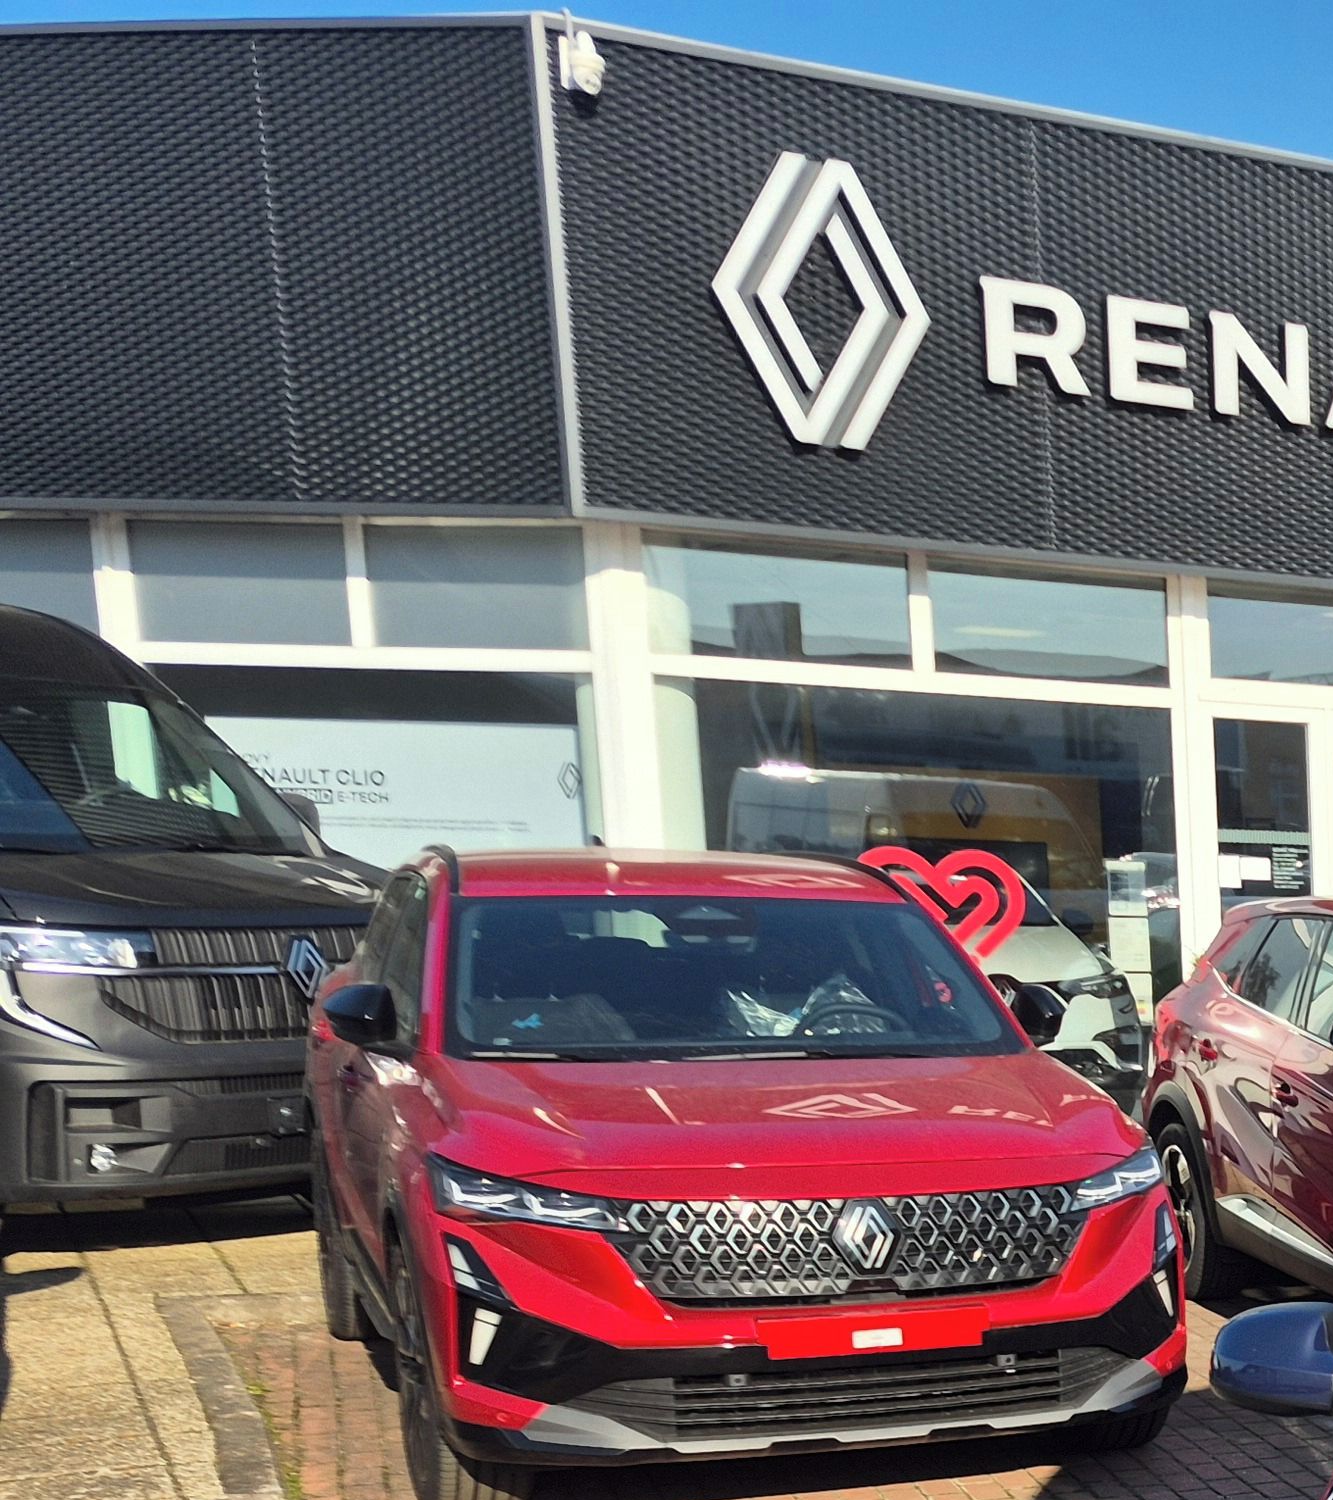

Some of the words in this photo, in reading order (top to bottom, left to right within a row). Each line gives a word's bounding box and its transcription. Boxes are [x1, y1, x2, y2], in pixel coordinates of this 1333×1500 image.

[254, 767, 330, 784] NAULT
[336, 769, 385, 787] CLIO
[337, 790, 389, 803] E-TECH
